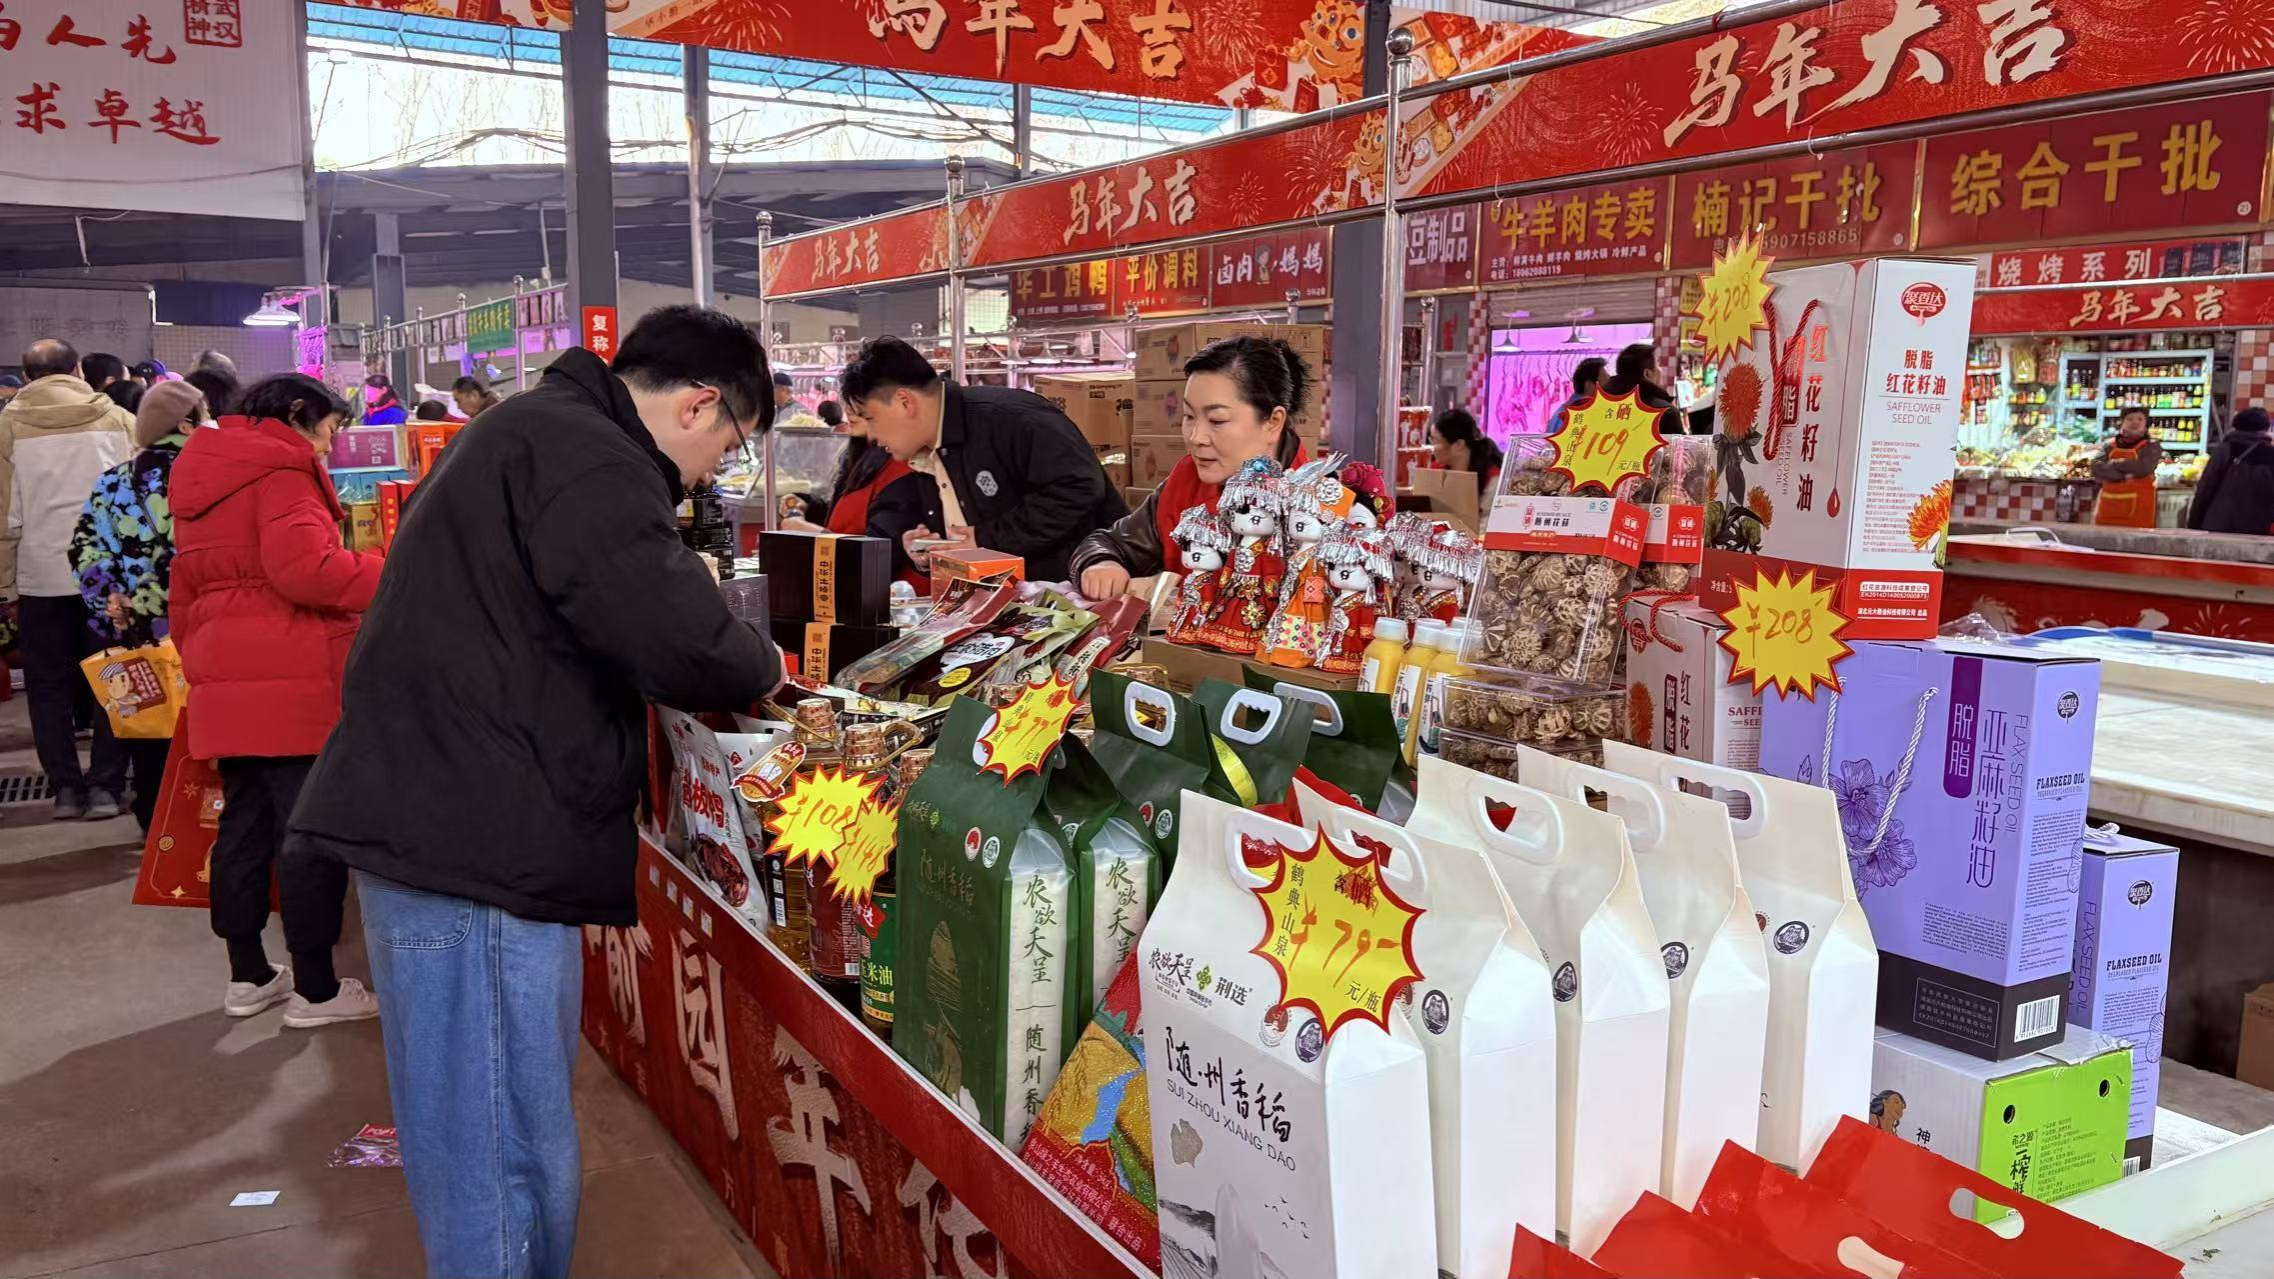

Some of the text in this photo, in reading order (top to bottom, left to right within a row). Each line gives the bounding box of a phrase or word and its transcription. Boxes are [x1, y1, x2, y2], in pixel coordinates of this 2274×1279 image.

[1951, 119, 2223, 216] 综合干批
[1063, 158, 1199, 246] 马年大吉
[1502, 186, 1657, 250] 牛羊肉专卖
[811, 227, 880, 285] 马年大吉
[1404, 211, 1468, 266] 豆制品
[1126, 248, 1198, 292] 平价调料
[1998, 248, 2152, 287] 烧烤系列
[2069, 284, 2226, 327] 马年大吉
[591, 314, 610, 360] 复称
[1904, 349, 1933, 370] 脱脂
[1886, 372, 1946, 396] 红花籽油
[1797, 324, 1828, 512] 红花籽油
[1887, 401, 1941, 414] SAFFLOWER
[1892, 413, 1932, 425] SEED OIL
[1680, 670, 1691, 750] 红花
[1949, 703, 1974, 778] 脱脂
[1966, 708, 2007, 888] 亚麻籽油
[2036, 772, 2086, 790] FLAXSEED OIL
[2004, 813, 2018, 837] OIL
[2106, 953, 2162, 971] FLAXSEED OIL
[1345, 981, 1382, 1013] 元/瓶
[1167, 1078, 1297, 1172] SUI ZHOU XIANG DAO
[1915, 1127, 1932, 1152] 神
